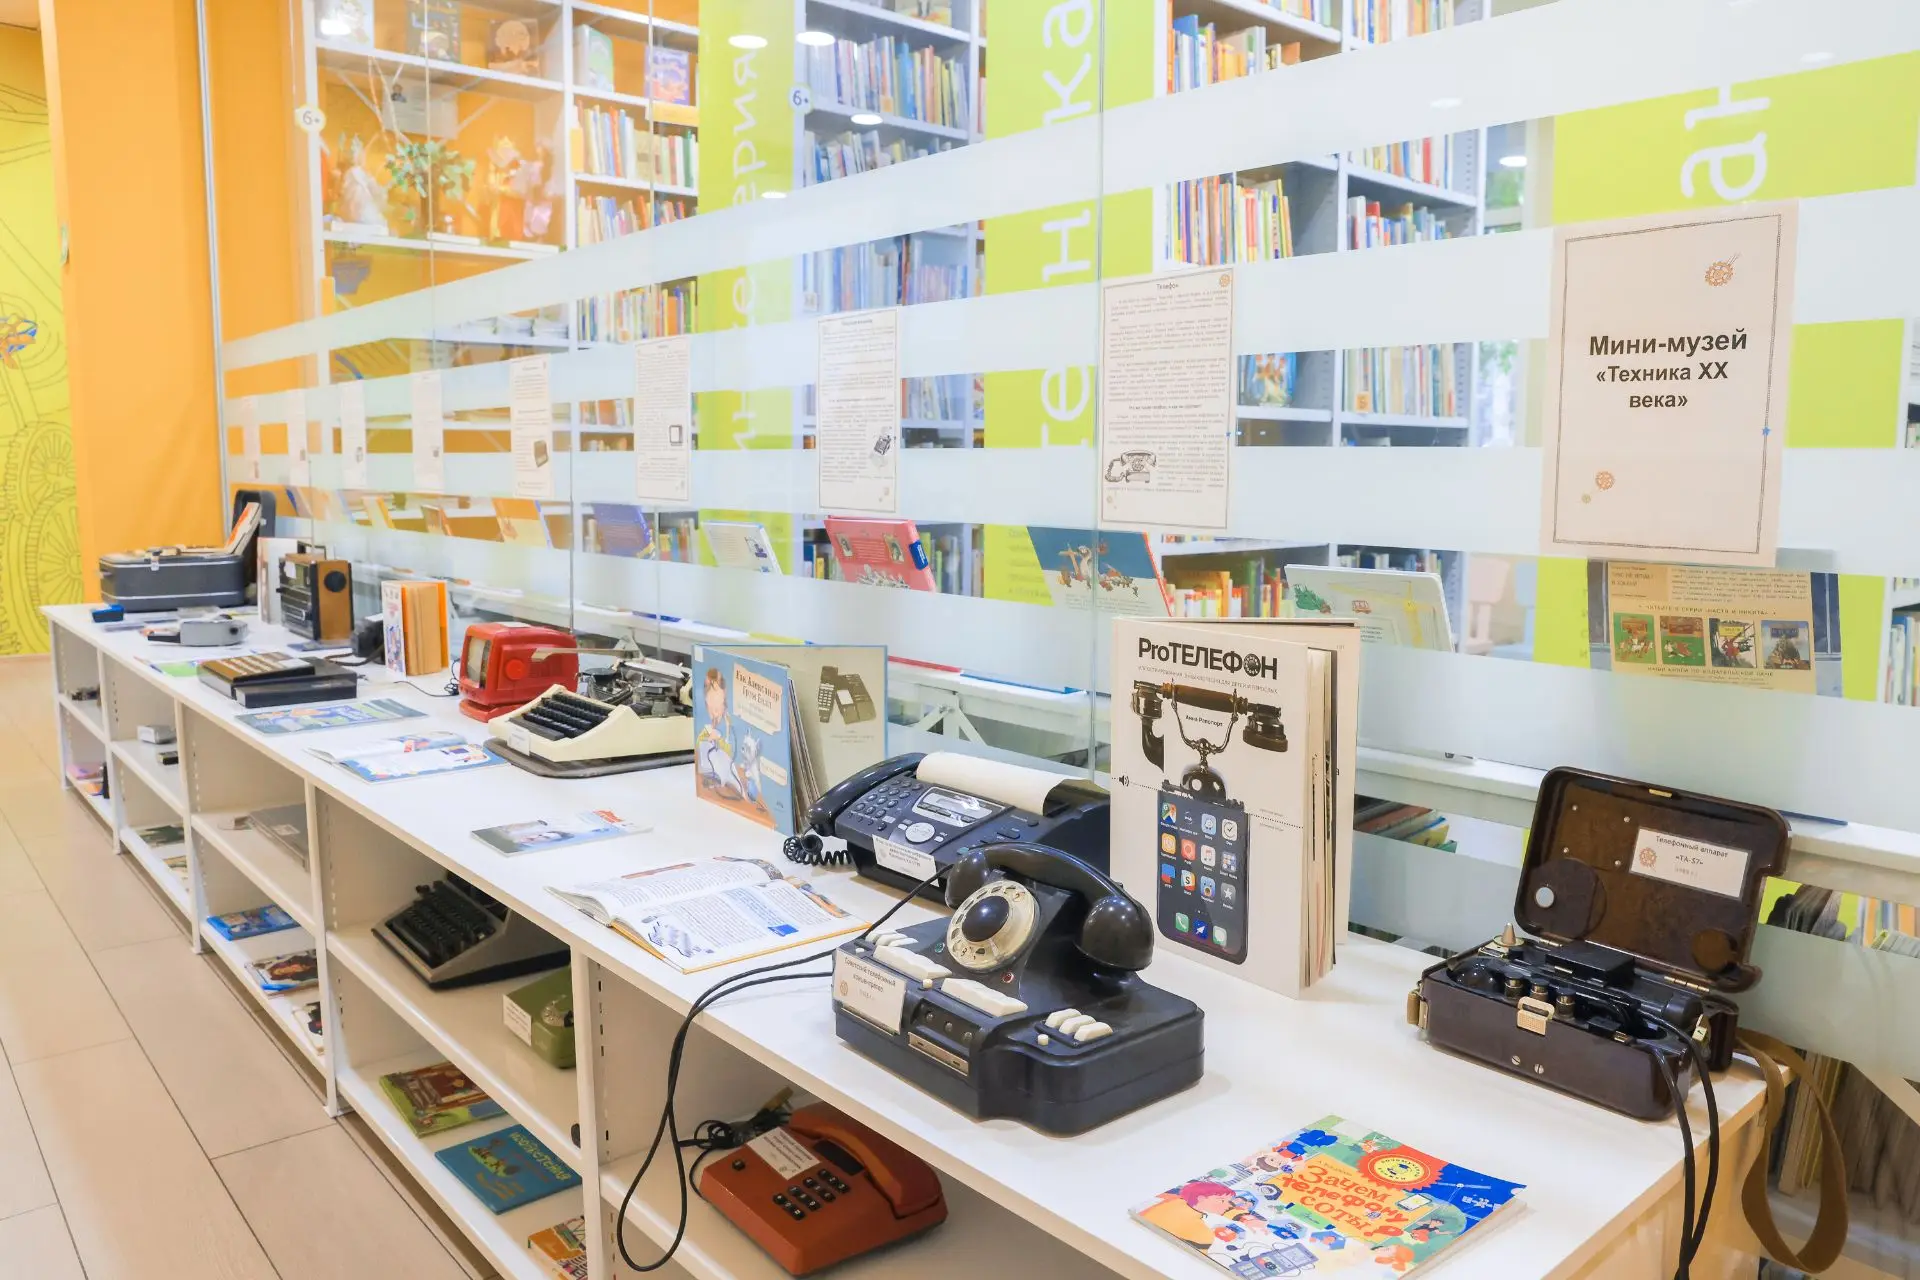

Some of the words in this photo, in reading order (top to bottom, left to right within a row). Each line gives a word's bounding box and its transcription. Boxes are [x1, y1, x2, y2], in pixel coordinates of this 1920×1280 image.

[1589, 328, 1748, 358] Мини-музей
[1596, 364, 1691, 383] «Техника
[1629, 392, 1688, 409] века»
[1656, 835, 1699, 851] Телефонный
[1700, 847, 1728, 858] аппарат
[1298, 1165, 1392, 1203] Зачем
[1277, 1175, 1409, 1223] телефону
